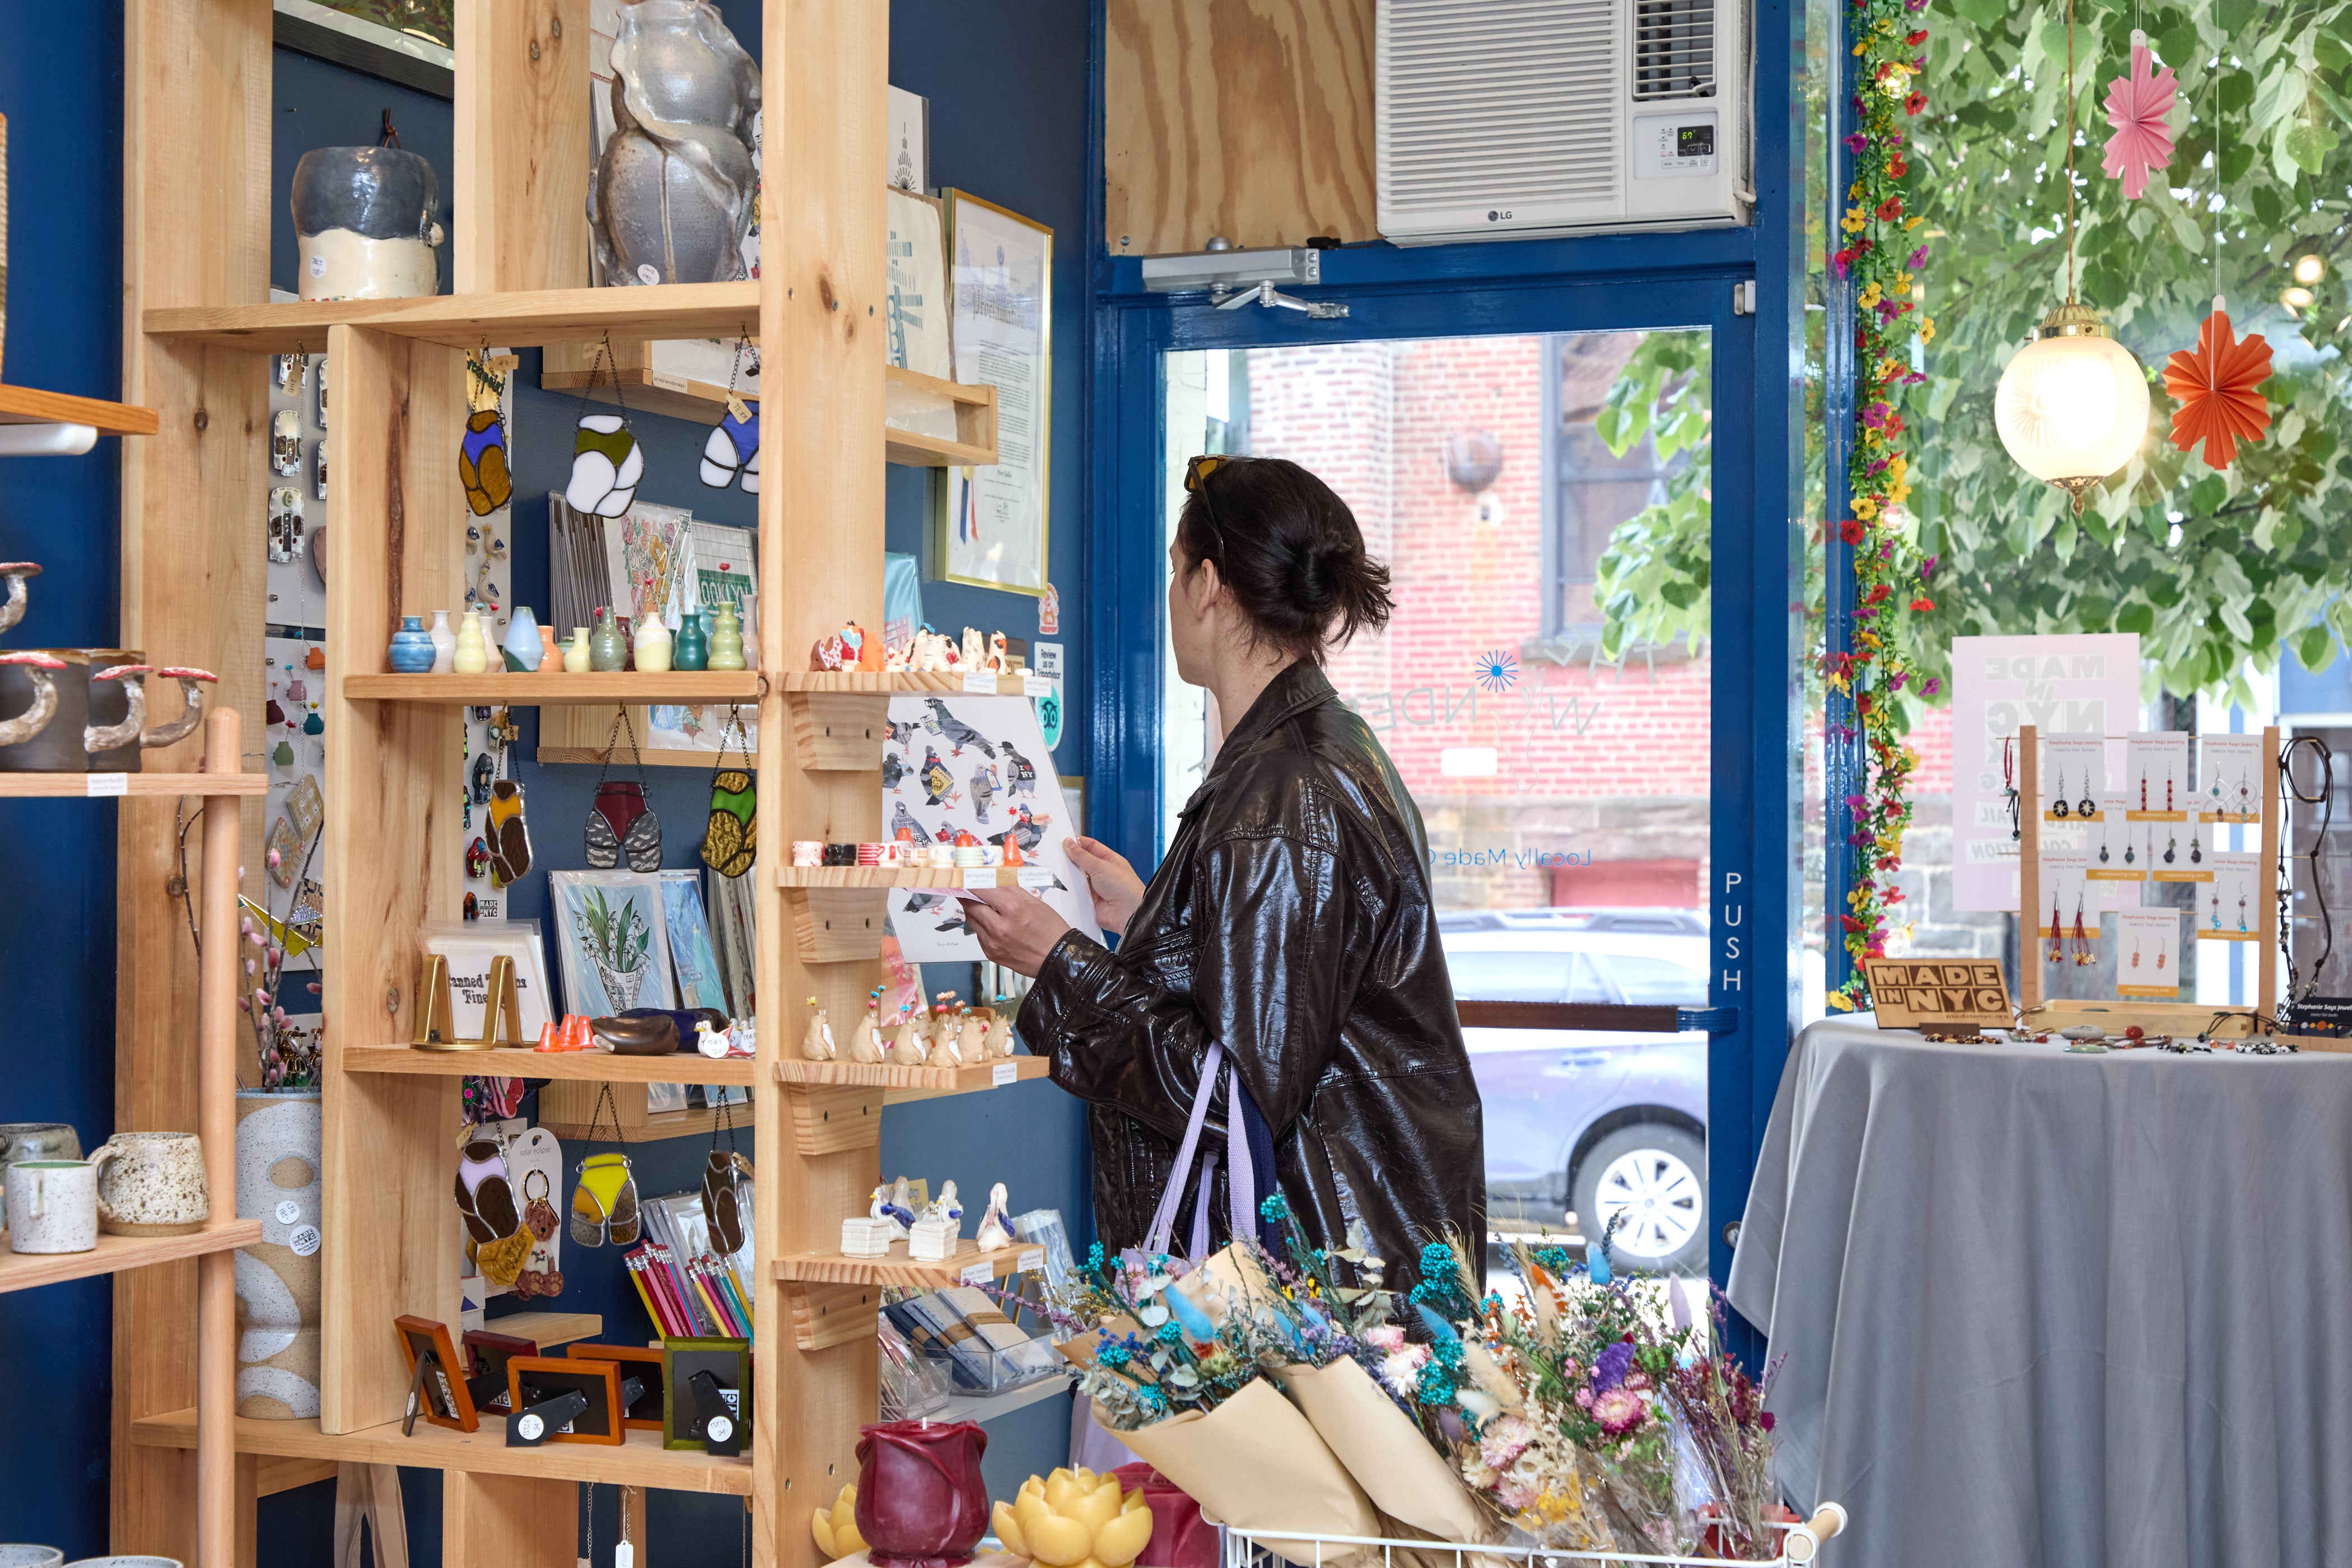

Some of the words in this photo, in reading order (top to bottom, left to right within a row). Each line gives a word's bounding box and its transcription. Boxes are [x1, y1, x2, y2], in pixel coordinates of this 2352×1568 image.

[701, 581, 749, 609] OOKLYN
[1041, 649, 1056, 659] Review
[1037, 669, 1061, 679] Tripadvisor
[935, 767, 952, 783] PLAYBILL
[483, 908, 497, 917] NYC
[1723, 872, 1742, 991] PUSH
[1873, 967, 2000, 986] MADE
[1878, 989, 1903, 1004] IN
[1906, 989, 2003, 1011] NYC
[505, 1232, 526, 1271] BUTTER
[710, 1420, 726, 1429] TST19
